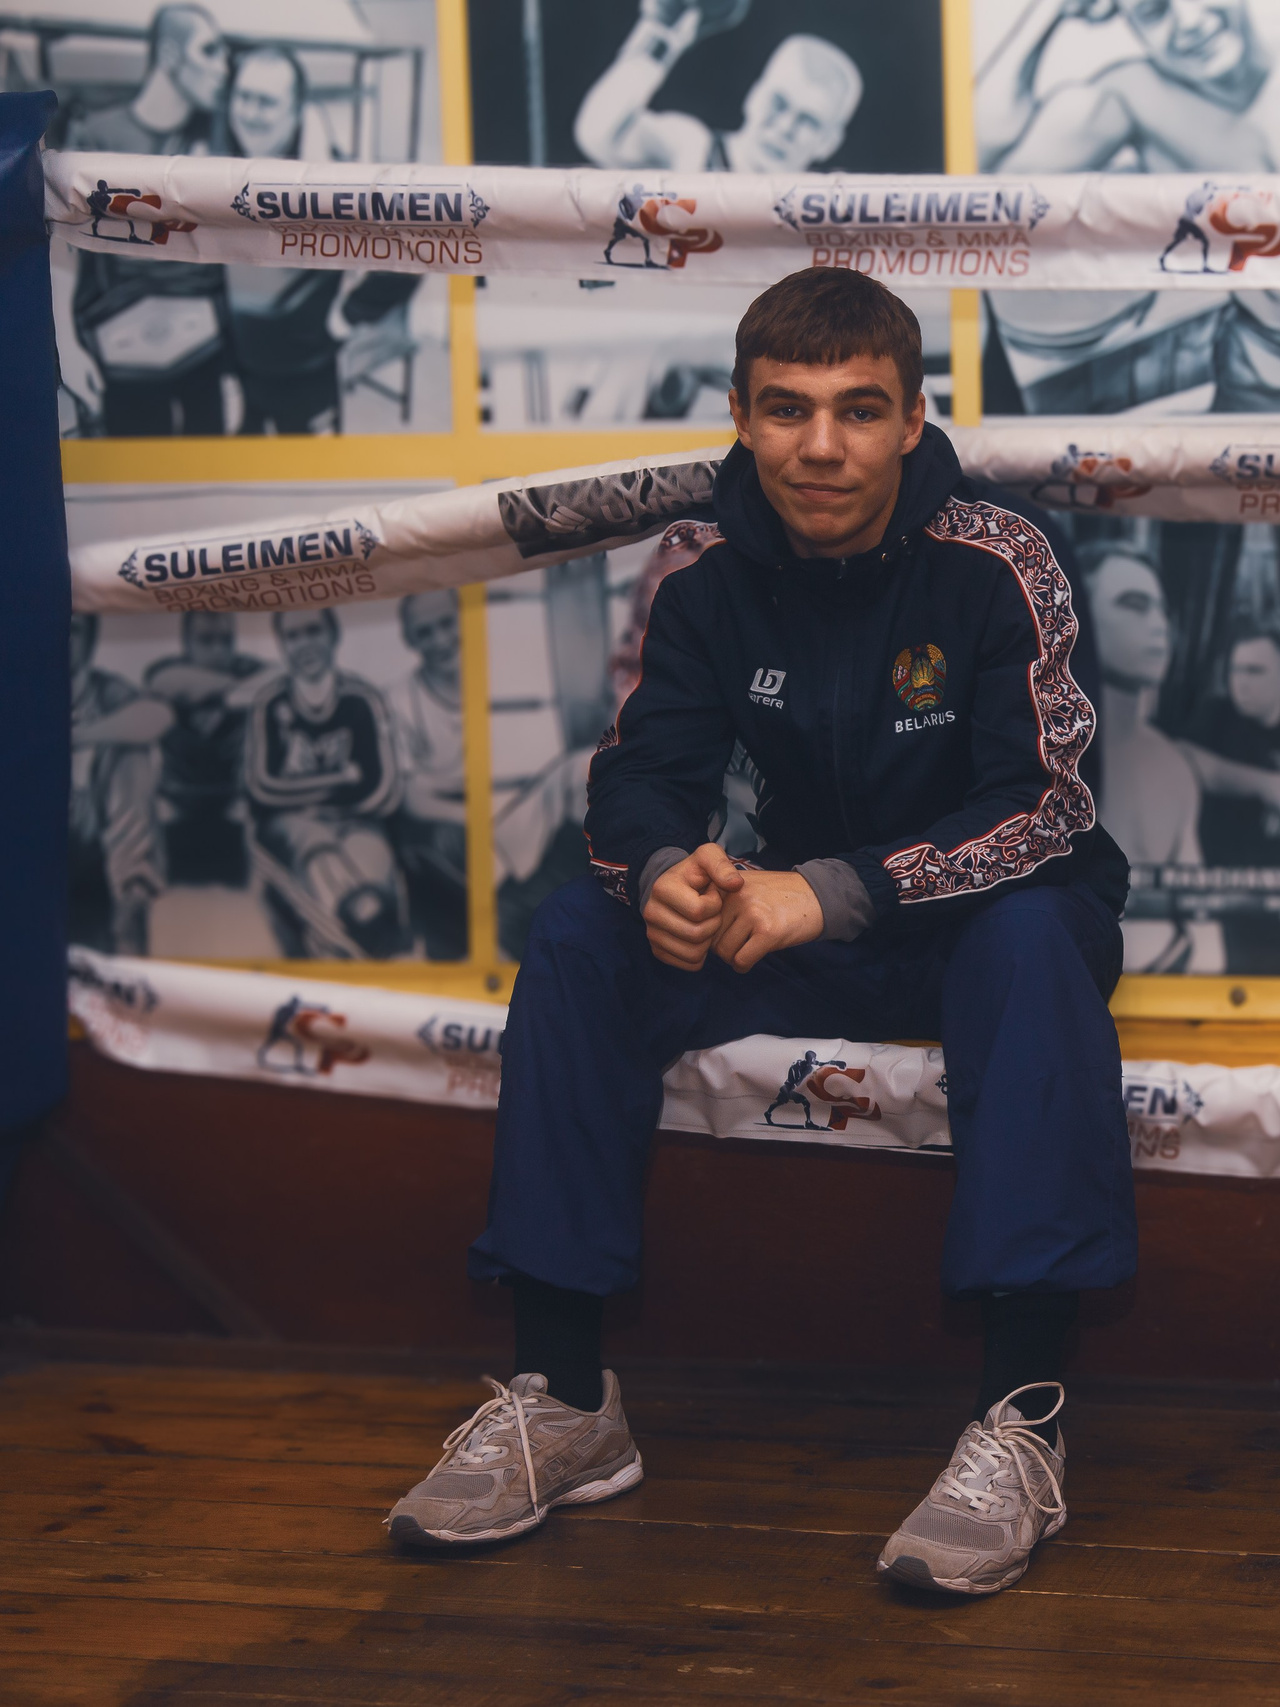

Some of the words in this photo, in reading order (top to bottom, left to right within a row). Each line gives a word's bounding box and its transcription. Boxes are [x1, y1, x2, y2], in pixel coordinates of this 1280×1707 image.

[257, 191, 462, 221] SULEIMEN
[801, 192, 1022, 224] SULEIMEN
[281, 232, 482, 264] PROMOTIONS
[803, 232, 914, 247] BOXING
[925, 230, 946, 247] &
[957, 231, 1031, 247] MMA
[812, 248, 1031, 276] PROMOTIONS
[144, 528, 354, 583] SULEIMEN
[154, 577, 260, 604] BOXING
[270, 572, 288, 587] &
[300, 562, 370, 583] MMA
[895, 711, 956, 733] BELARUS
